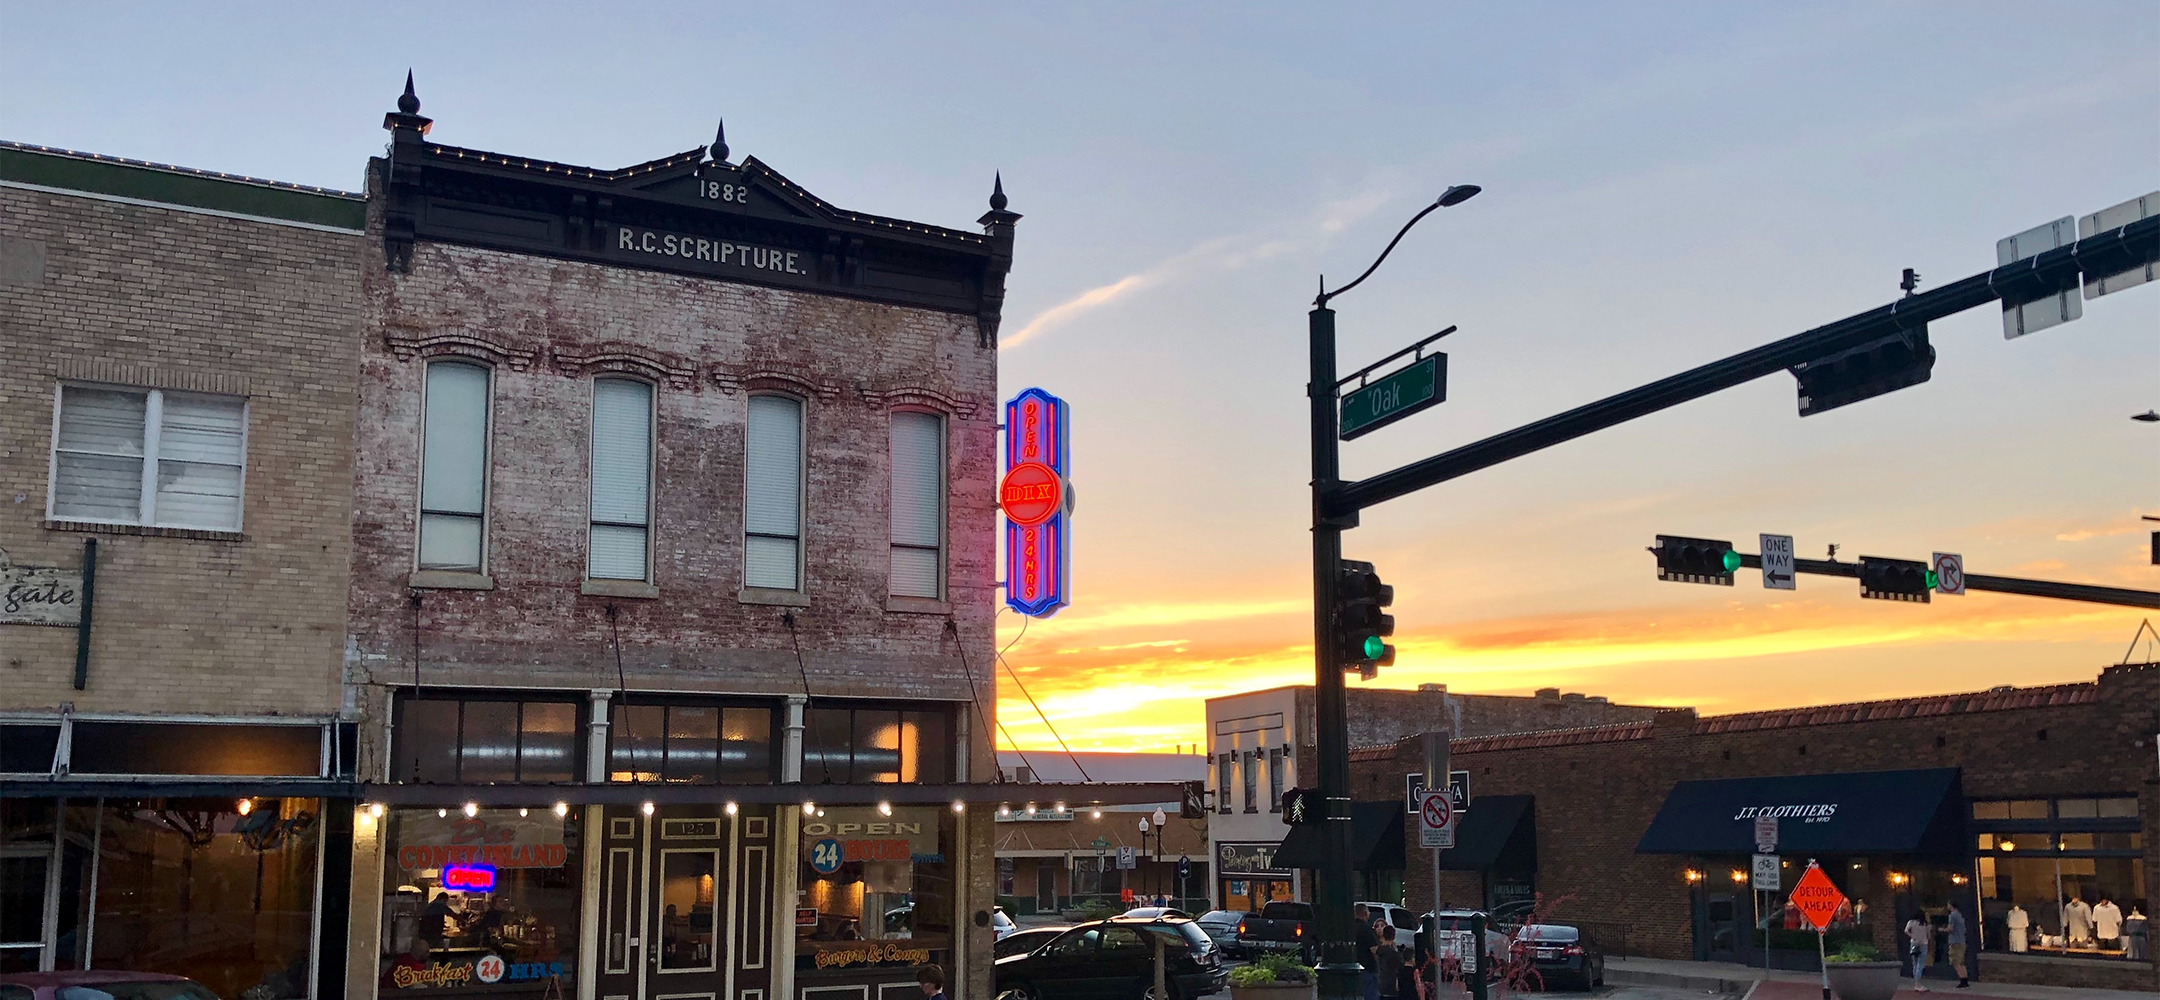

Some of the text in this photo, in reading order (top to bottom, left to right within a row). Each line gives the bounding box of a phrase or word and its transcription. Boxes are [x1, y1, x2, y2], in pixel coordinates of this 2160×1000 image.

[700, 179, 747, 204] 1882
[1371, 381, 1401, 416] Oak
[1025, 402, 1038, 458] OPEN
[1006, 484, 1052, 502] DIX
[1765, 538, 1788, 552] ONE
[1766, 554, 1790, 568] WAY
[4, 579, 75, 613] gate
[1758, 803, 1838, 818] CLOTHIERS
[803, 822, 921, 836] OPEN
[400, 844, 567, 870] CONEY ISLAND
[814, 843, 839, 869] 24
[844, 838, 911, 862] HOURS
[449, 869, 491, 887] OPEN
[1799, 886, 1834, 898] DETOUR
[1803, 900, 1834, 912] AHEAD
[815, 949, 867, 970] Burgers
[867, 944, 884, 963] &
[393, 960, 564, 988] Breakfast 24 HRS
